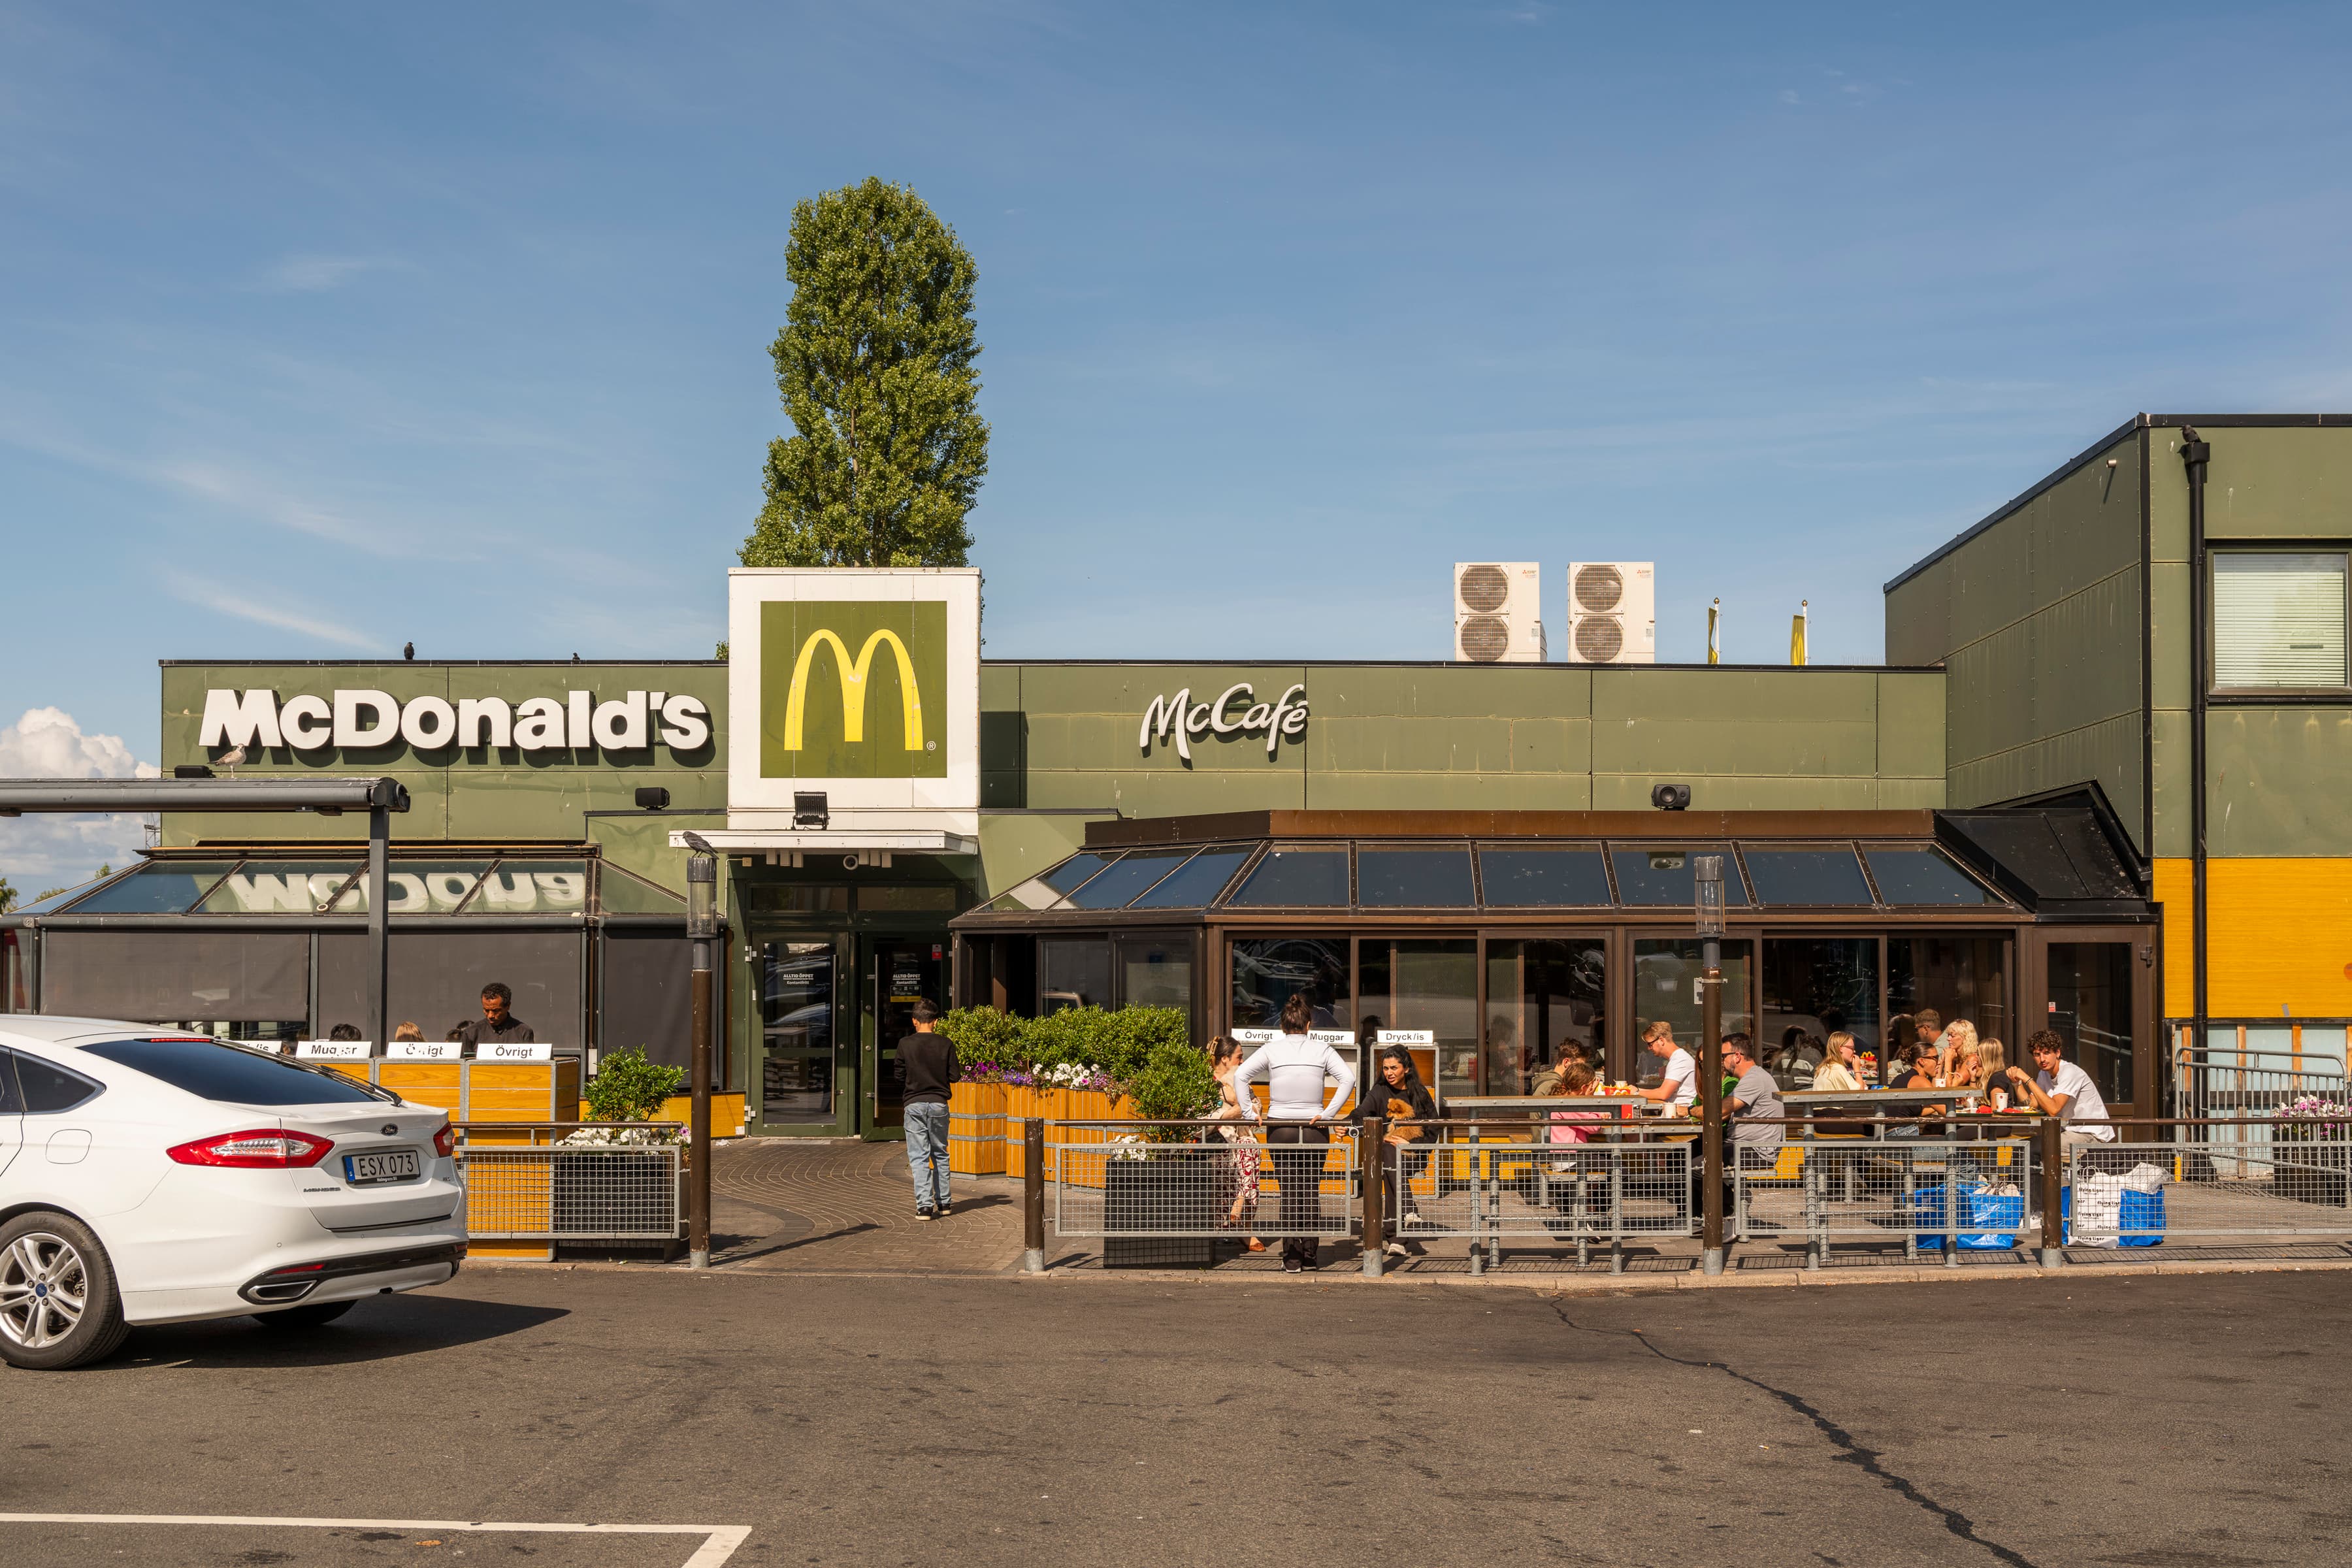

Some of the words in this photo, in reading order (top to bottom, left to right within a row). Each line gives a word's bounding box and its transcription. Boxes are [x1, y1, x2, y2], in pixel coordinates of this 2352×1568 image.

[199, 689, 709, 750] McDonald's
[1139, 683, 1309, 759] McCafé
[1245, 1030, 1273, 1040] Övrigt
[1310, 1033, 1345, 1042] Muggar
[1386, 1033, 1424, 1041] Dryck/is
[495, 1045, 533, 1058] Övrigt
[358, 1156, 386, 1177] ESX
[389, 1154, 414, 1174] 073
